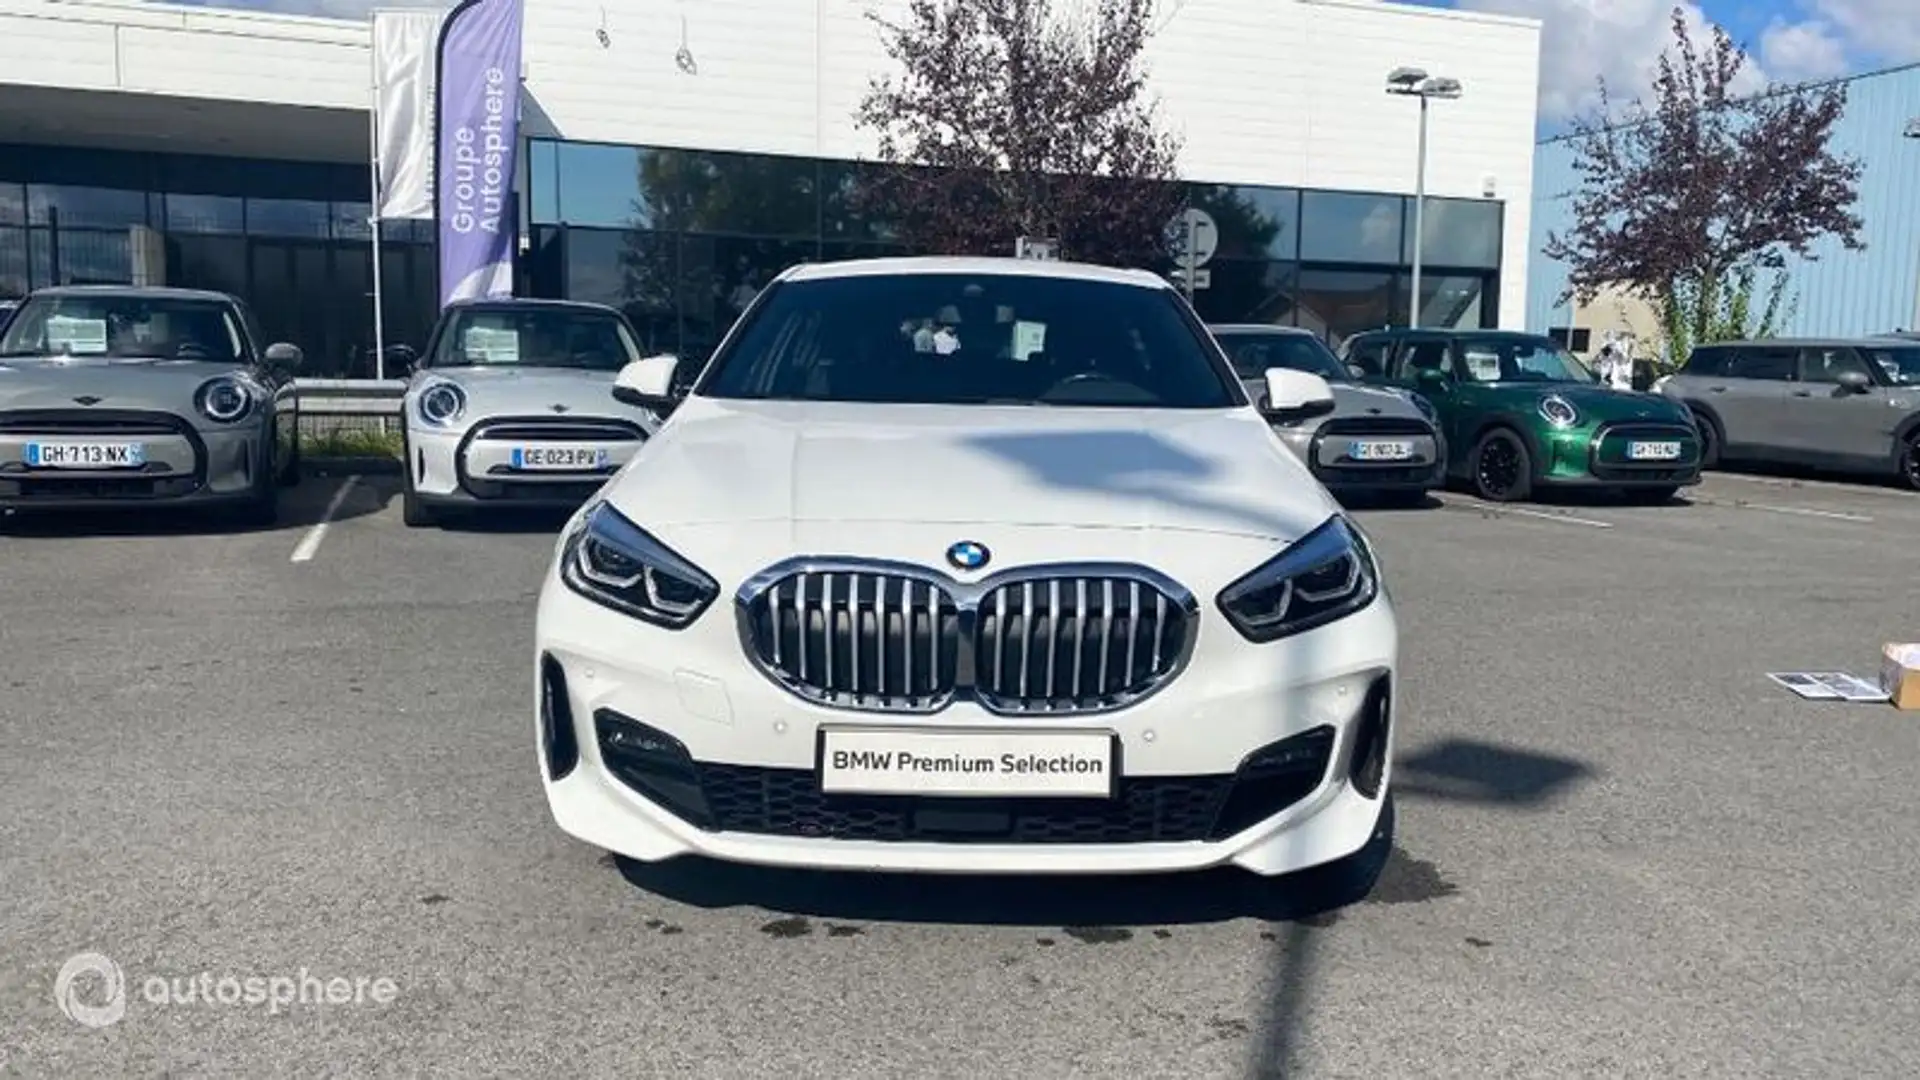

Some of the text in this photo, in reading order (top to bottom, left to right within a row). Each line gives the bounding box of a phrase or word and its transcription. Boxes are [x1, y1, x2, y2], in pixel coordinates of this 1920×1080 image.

[451, 126, 482, 234] Groupe
[479, 67, 510, 234] Autosphere
[832, 750, 1103, 774] BMW Premium Selection
